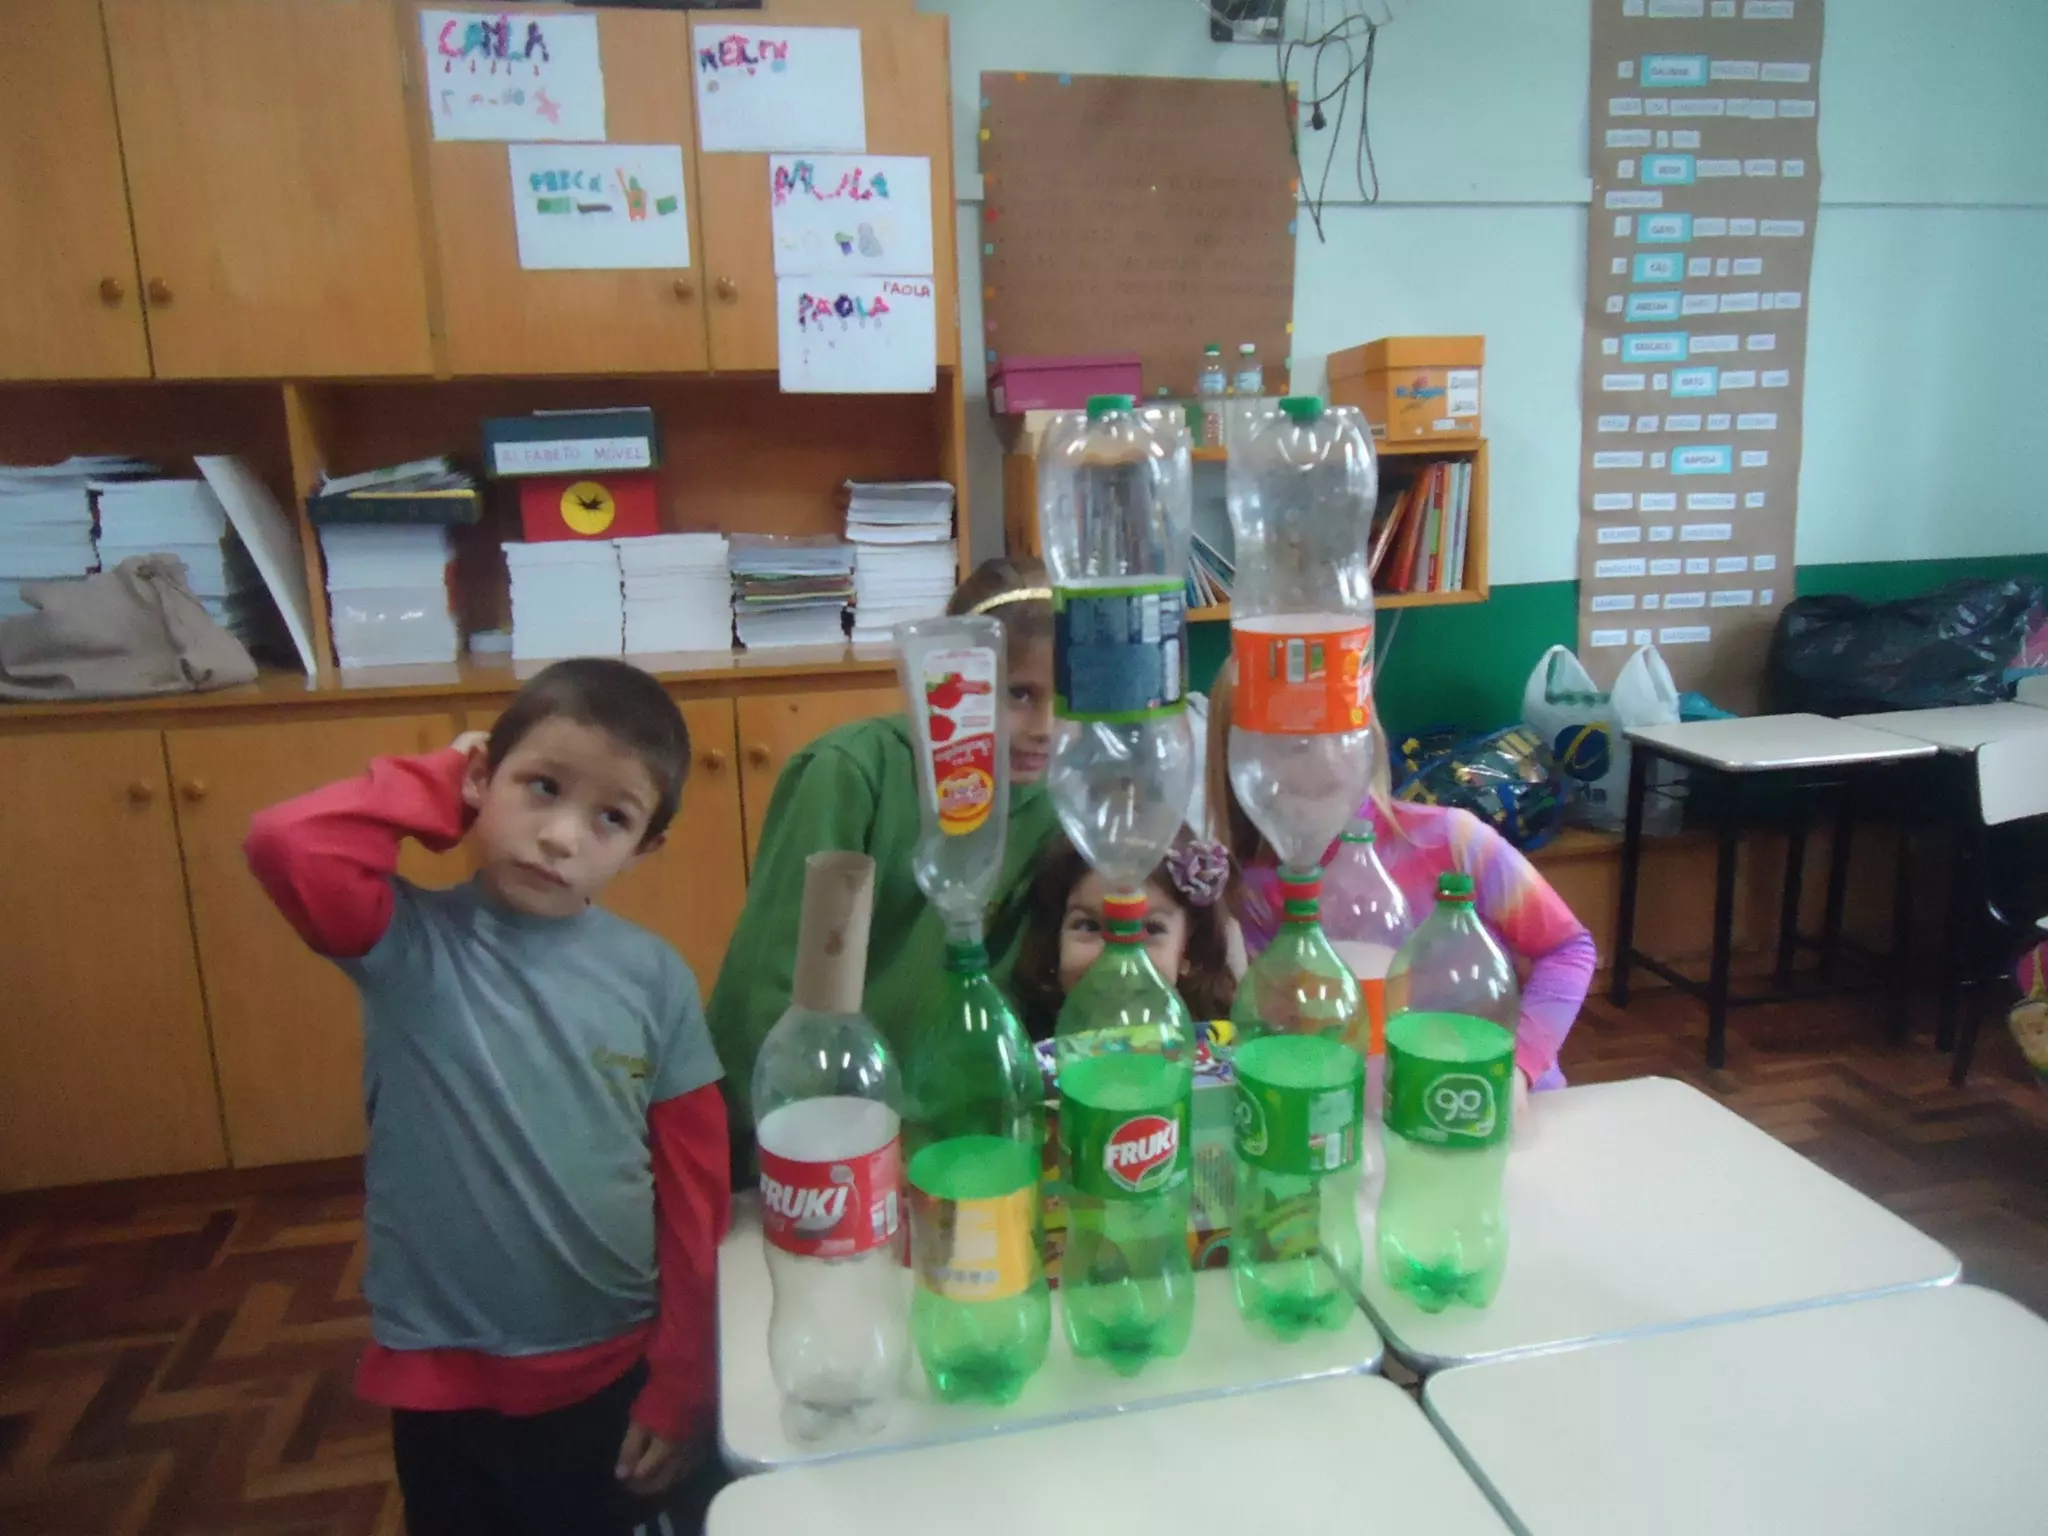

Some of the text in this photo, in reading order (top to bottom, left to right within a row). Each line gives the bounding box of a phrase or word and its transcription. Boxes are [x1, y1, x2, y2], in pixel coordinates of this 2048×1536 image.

[883, 281, 931, 297] PAOLA
[799, 292, 890, 324] PAOLA
[1103, 1118, 1179, 1171] FRUKI
